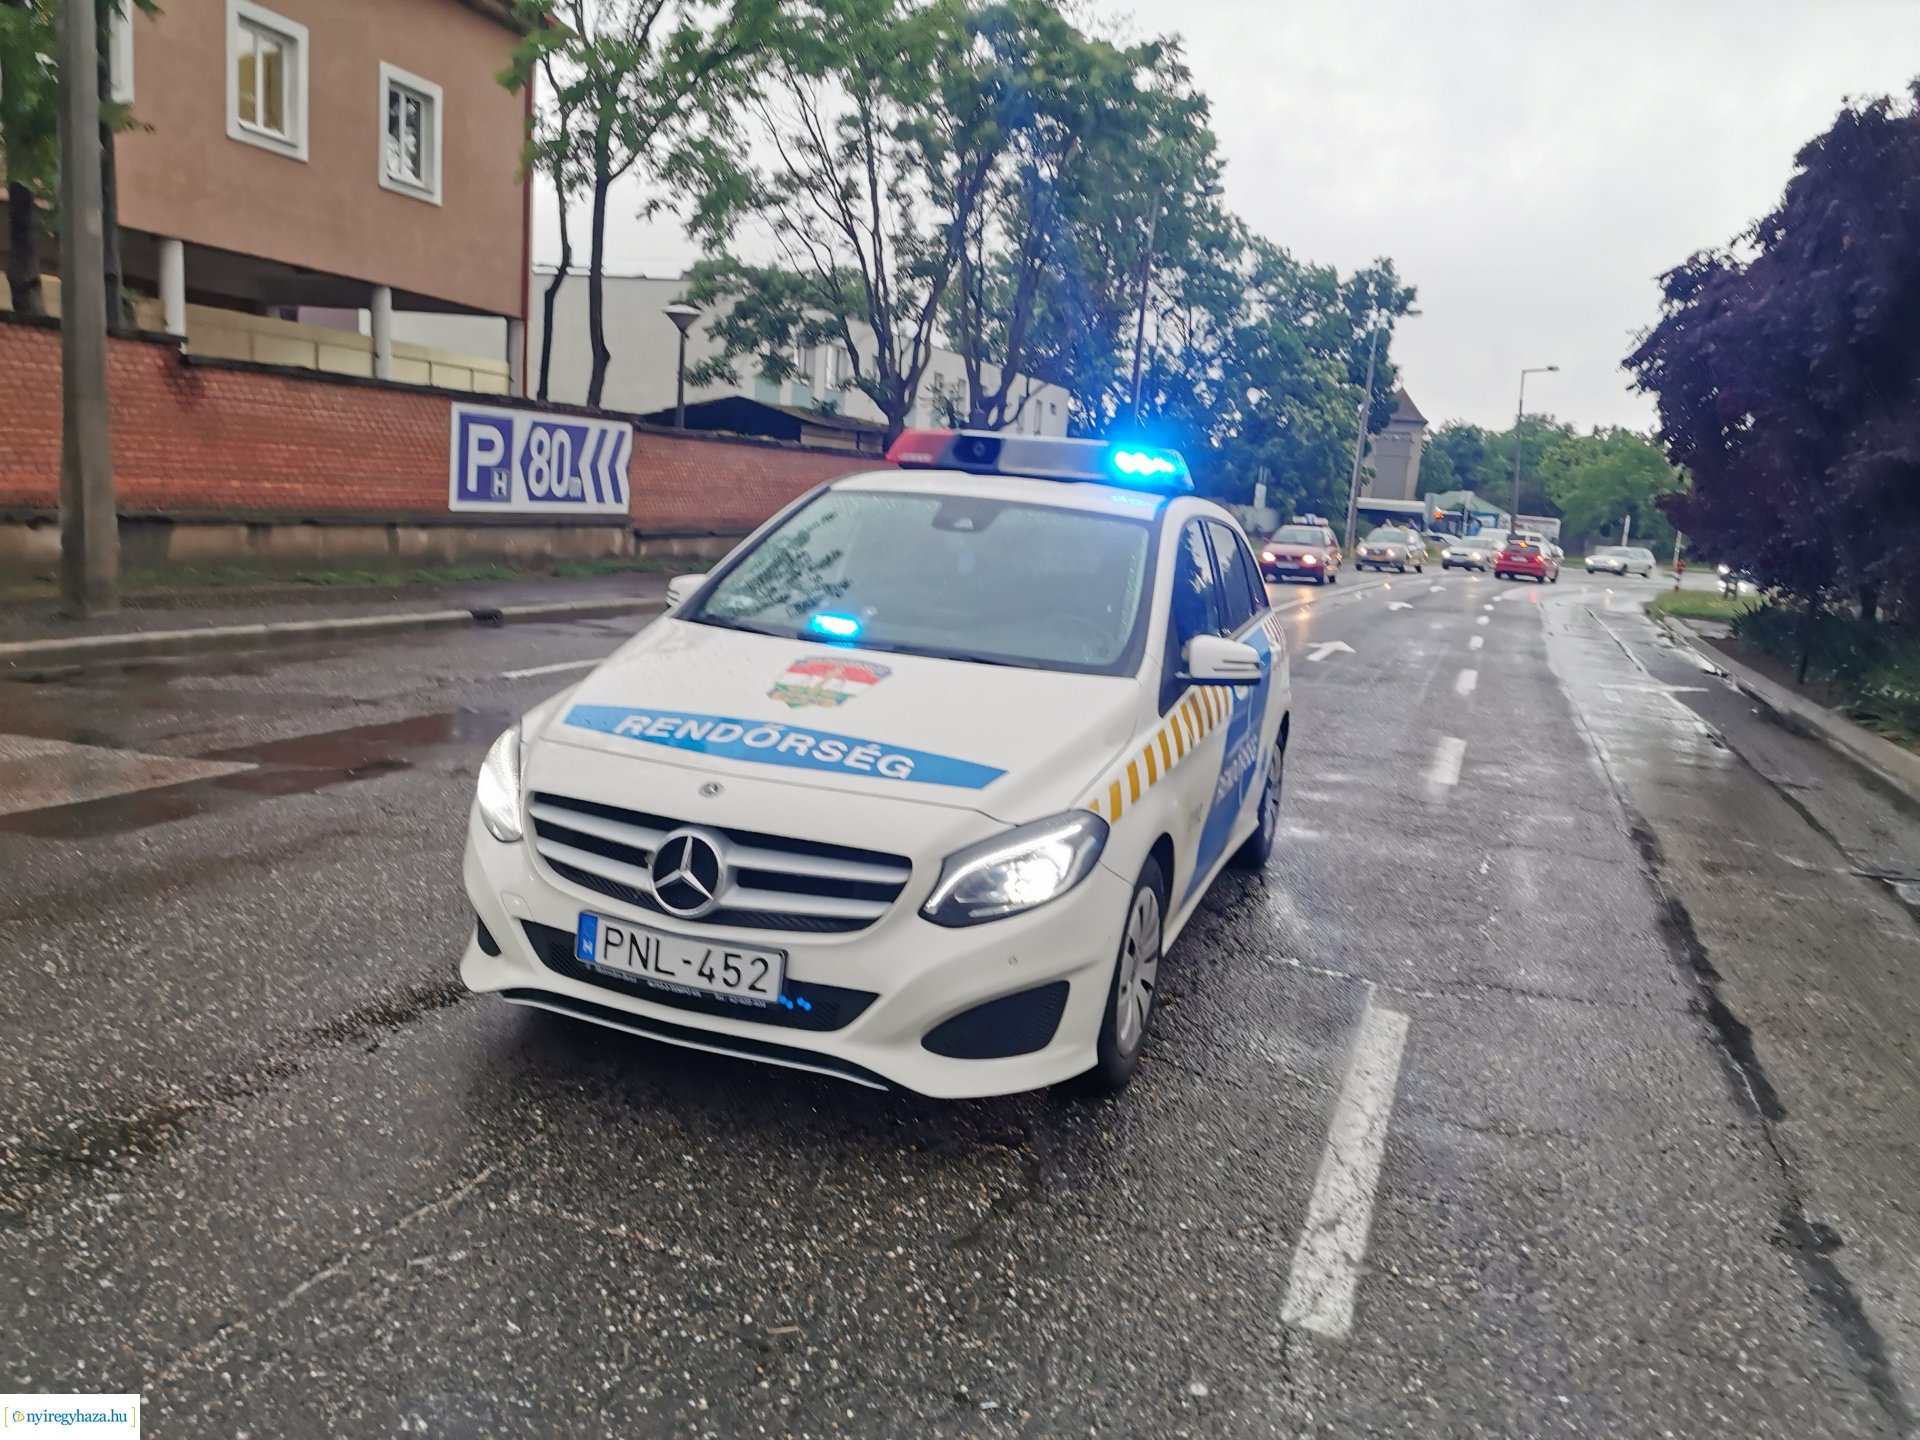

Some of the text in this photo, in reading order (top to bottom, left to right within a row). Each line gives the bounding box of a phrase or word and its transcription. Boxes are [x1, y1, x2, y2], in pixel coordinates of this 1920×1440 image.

[467, 422, 505, 493] P
[613, 714, 916, 780] RENDŐRSÉG
[603, 926, 769, 994] PNL-452
